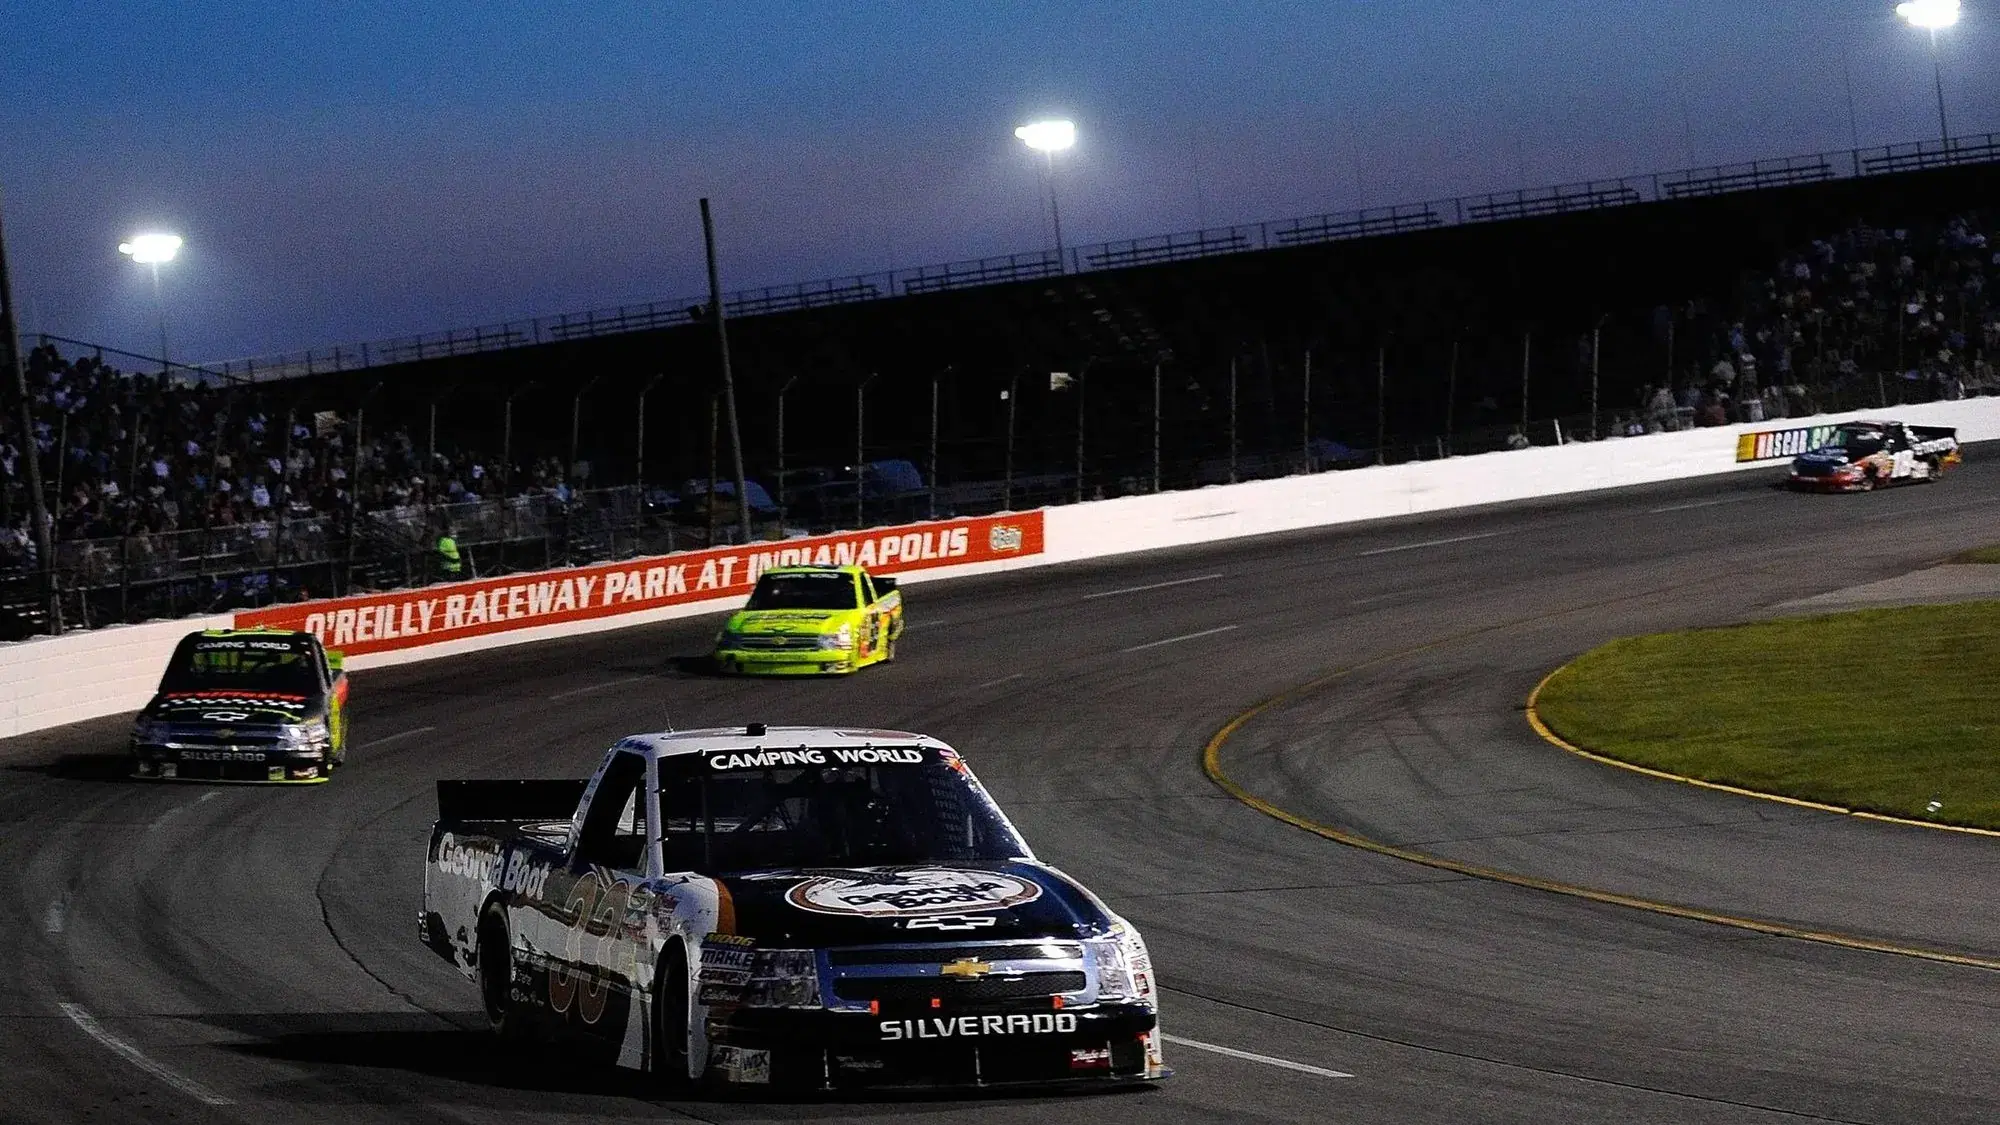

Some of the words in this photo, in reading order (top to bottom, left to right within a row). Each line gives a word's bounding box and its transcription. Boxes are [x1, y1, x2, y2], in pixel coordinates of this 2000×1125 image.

[305, 598, 438, 646] O'REILLY
[444, 575, 597, 629] RACEWAY
[602, 564, 687, 606] PARK
[697, 556, 738, 591] AT
[746, 527, 969, 585] INDIANAPOLIS
[250, 641, 292, 650] WORLD
[180, 750, 267, 762] SILVERADO
[710, 750, 827, 770] CAMPING
[831, 749, 924, 763] WORLD
[503, 848, 550, 901] Boot
[549, 871, 629, 1025] 33
[700, 949, 756, 966] MAHLE
[880, 1013, 1077, 1041] SILVERADO
